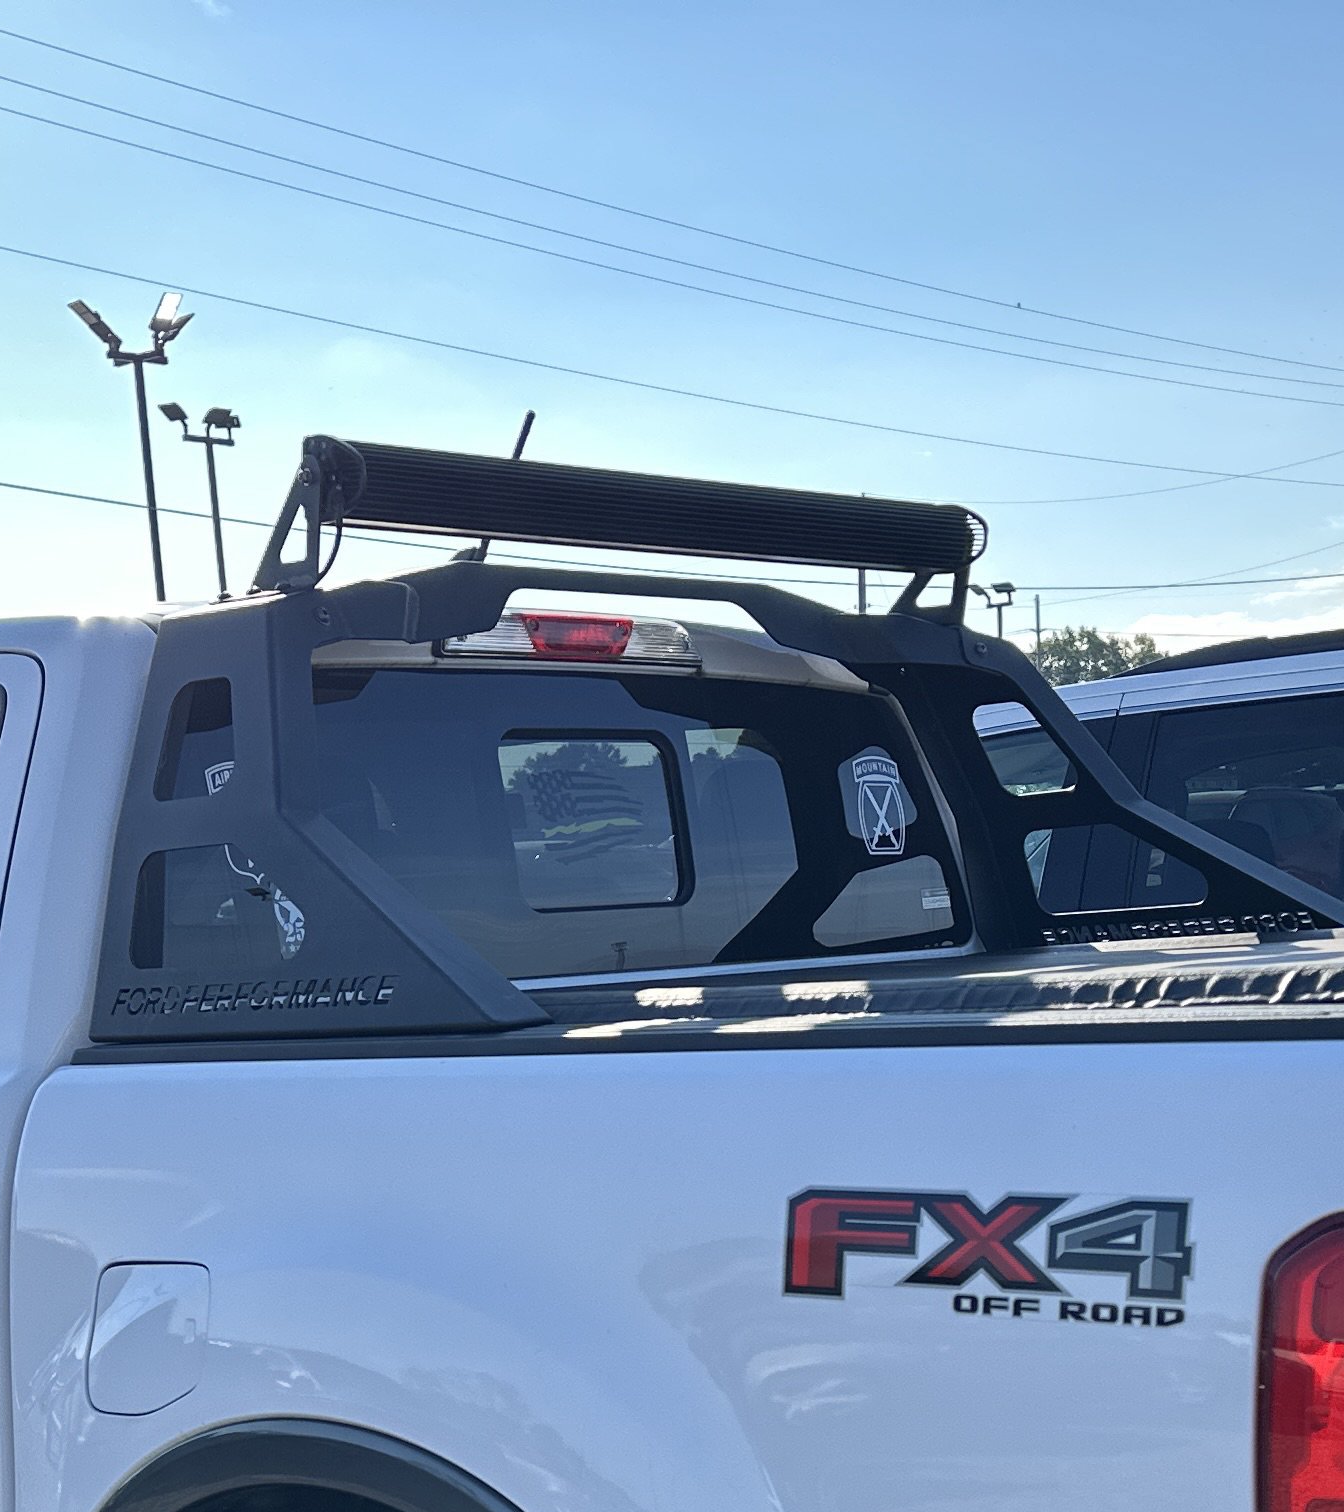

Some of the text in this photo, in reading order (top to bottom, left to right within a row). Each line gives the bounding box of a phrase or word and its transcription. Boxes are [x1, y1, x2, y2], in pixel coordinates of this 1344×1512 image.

[856, 762, 896, 776] MOUNTAIN
[111, 975, 400, 1015] FORD PERFORMANCE
[782, 1185, 1194, 1303] FX4
[953, 1294, 1185, 1327] OFF ROAD
